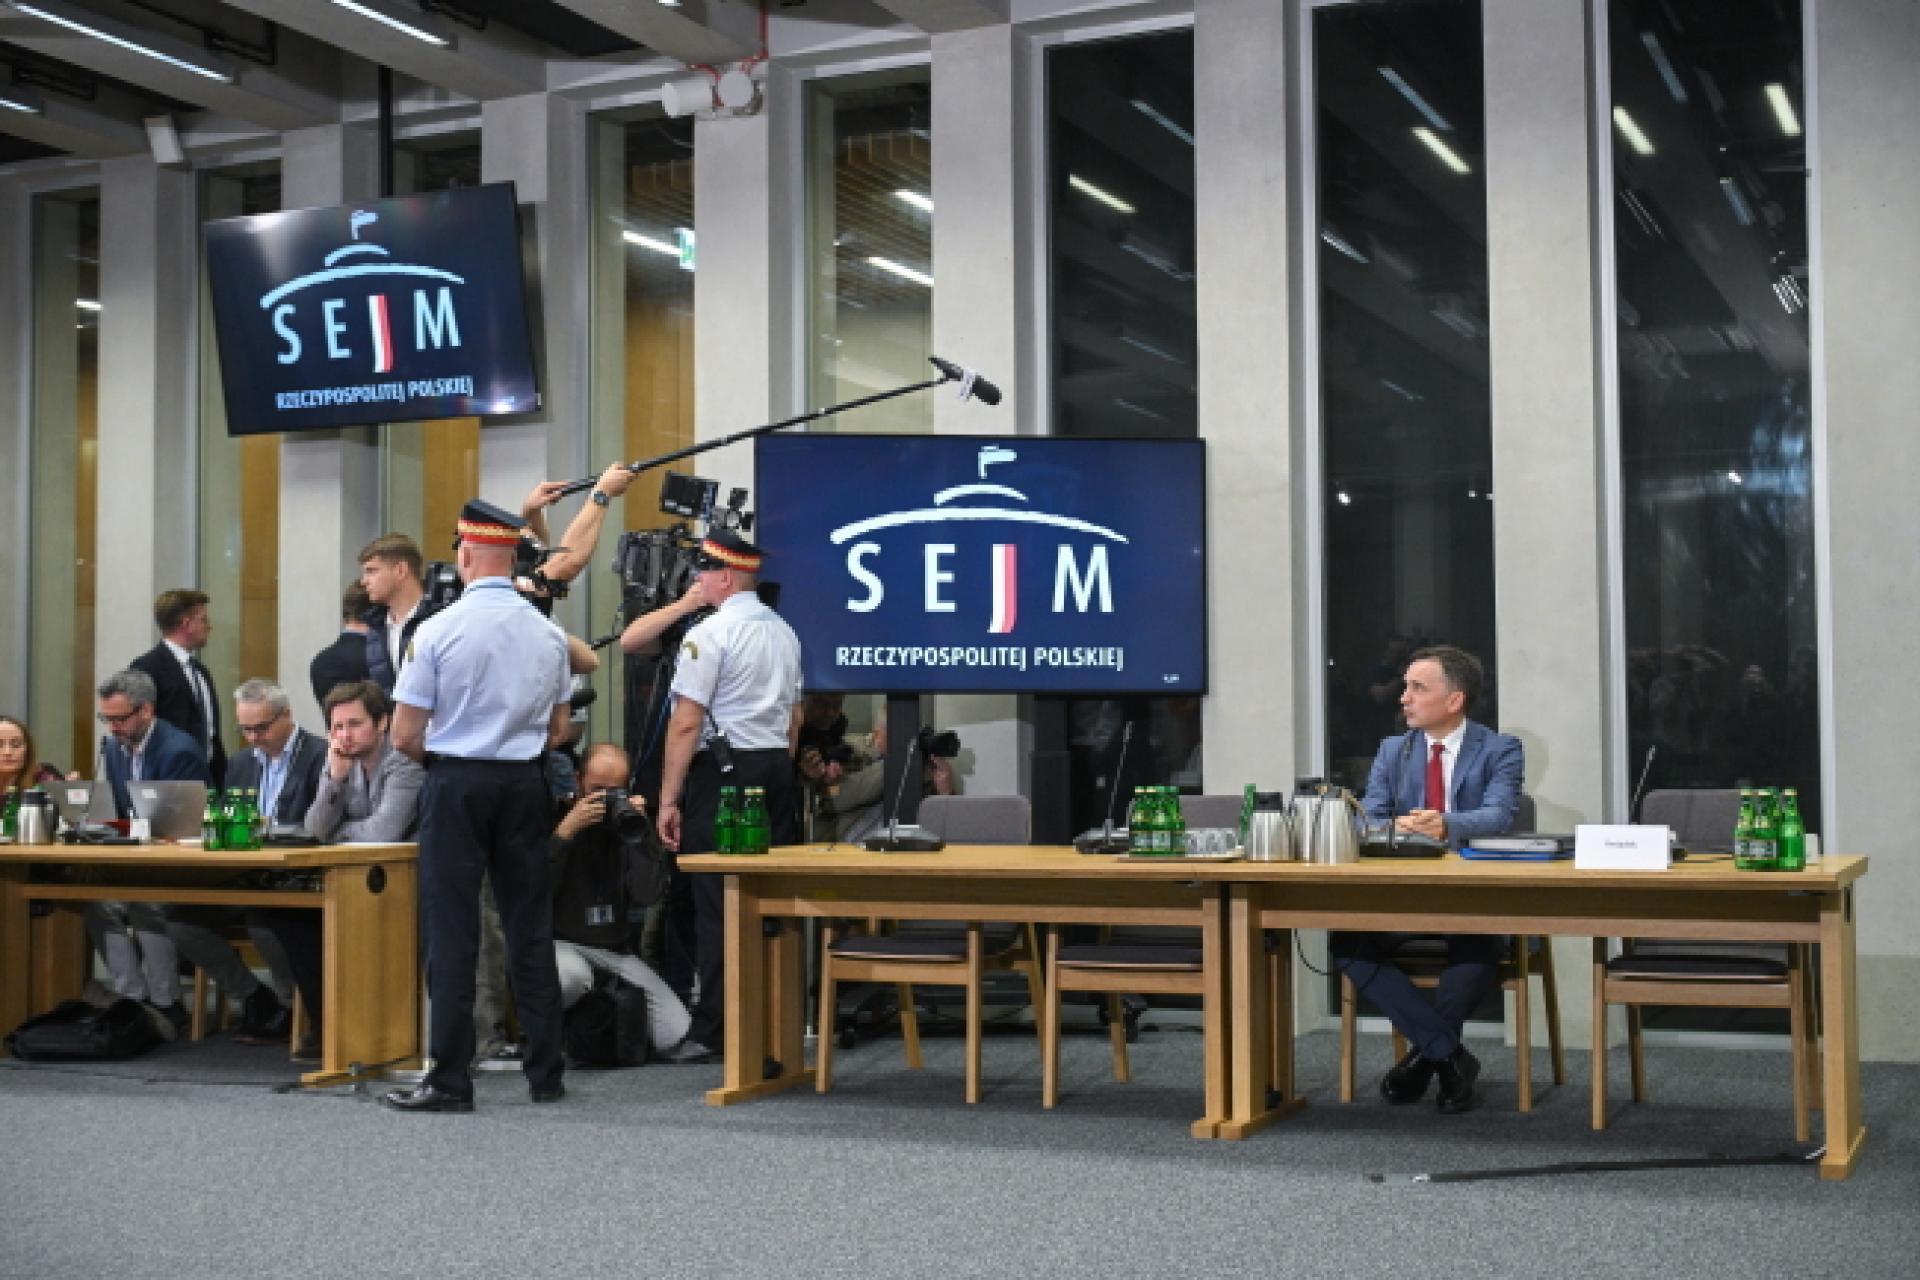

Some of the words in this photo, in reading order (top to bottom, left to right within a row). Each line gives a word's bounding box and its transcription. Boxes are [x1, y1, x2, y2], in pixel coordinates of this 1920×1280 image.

[273, 287, 461, 373] SEJM
[846, 542, 1114, 633] SEJM
[836, 646, 1027, 671] RZECZYPOSPOLITEJ
[1034, 646, 1124, 671] POLSKIEJ
